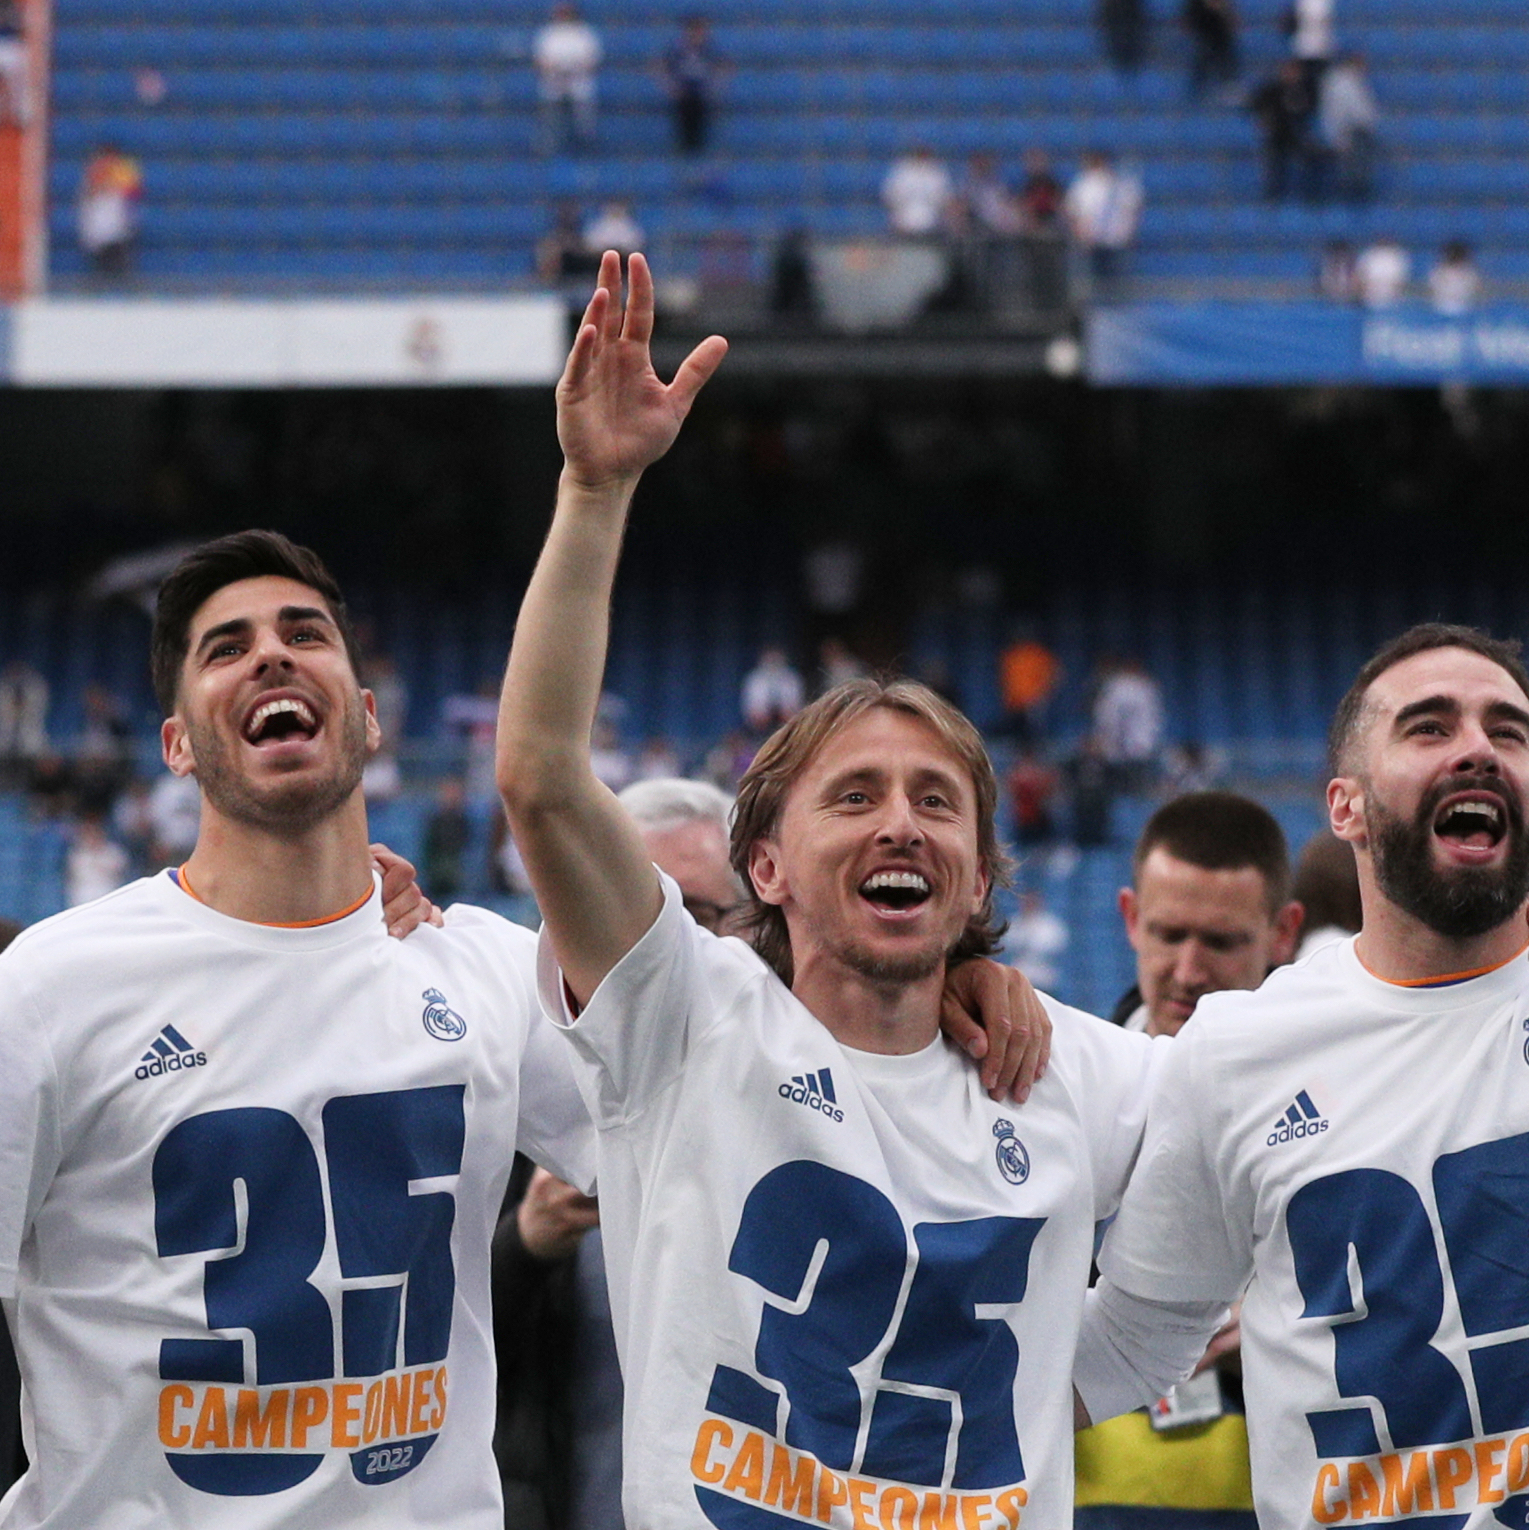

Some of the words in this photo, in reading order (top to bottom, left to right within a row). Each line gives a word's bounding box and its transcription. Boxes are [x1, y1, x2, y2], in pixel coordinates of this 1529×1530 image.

[134, 1050, 208, 1081] adidas
[778, 1083, 845, 1123] adidas
[1266, 1119, 1329, 1147] adidas
[152, 1084, 466, 1496] 35
[158, 1366, 448, 1449] CAMPEONES
[366, 1446, 413, 1475] 2022
